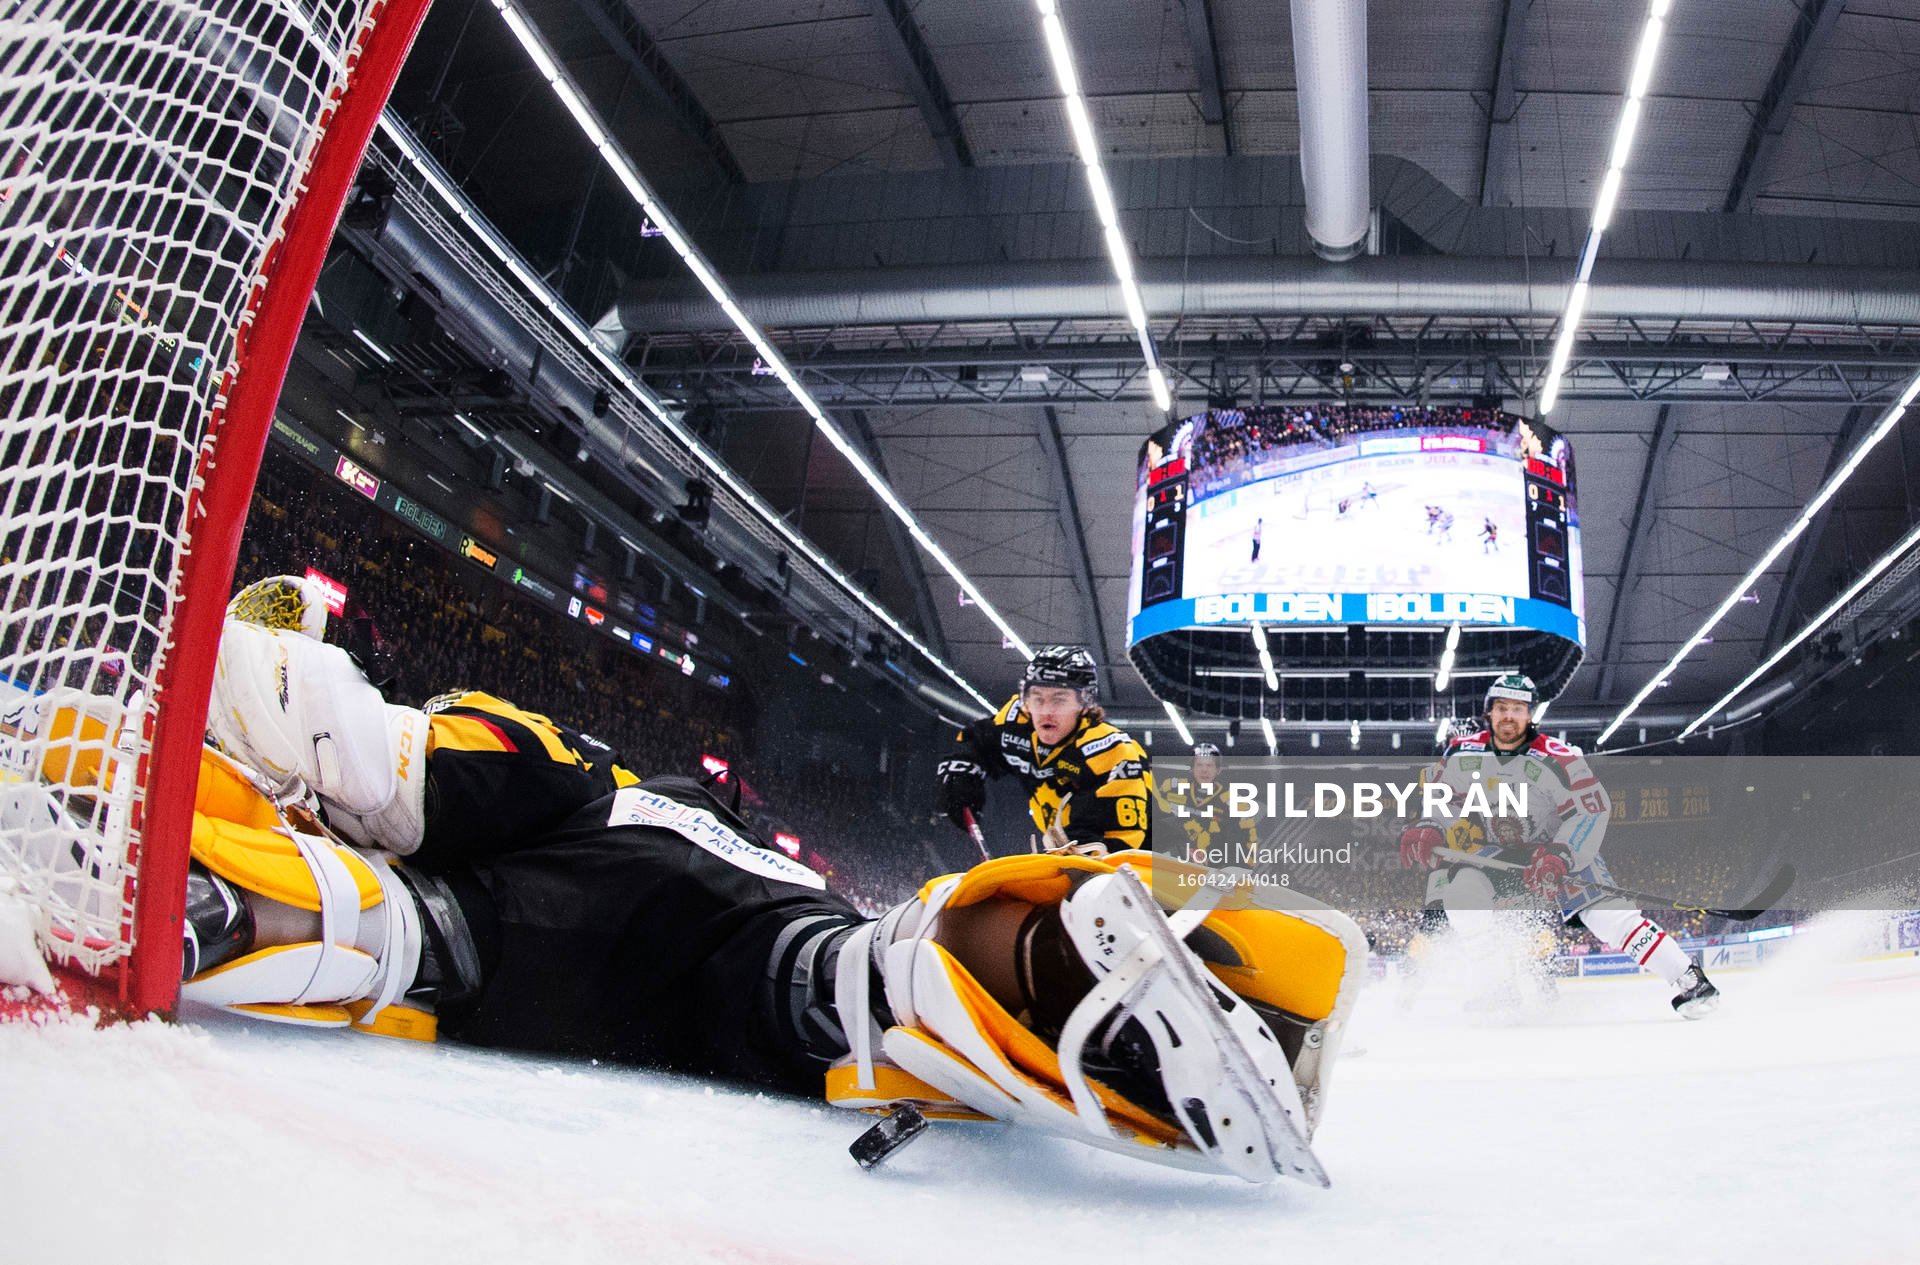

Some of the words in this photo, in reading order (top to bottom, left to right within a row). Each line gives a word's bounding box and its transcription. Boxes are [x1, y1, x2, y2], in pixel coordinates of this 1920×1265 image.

[396, 713, 414, 782] CCM
[937, 760, 987, 780] CCM
[692, 815, 806, 876] WELDING
